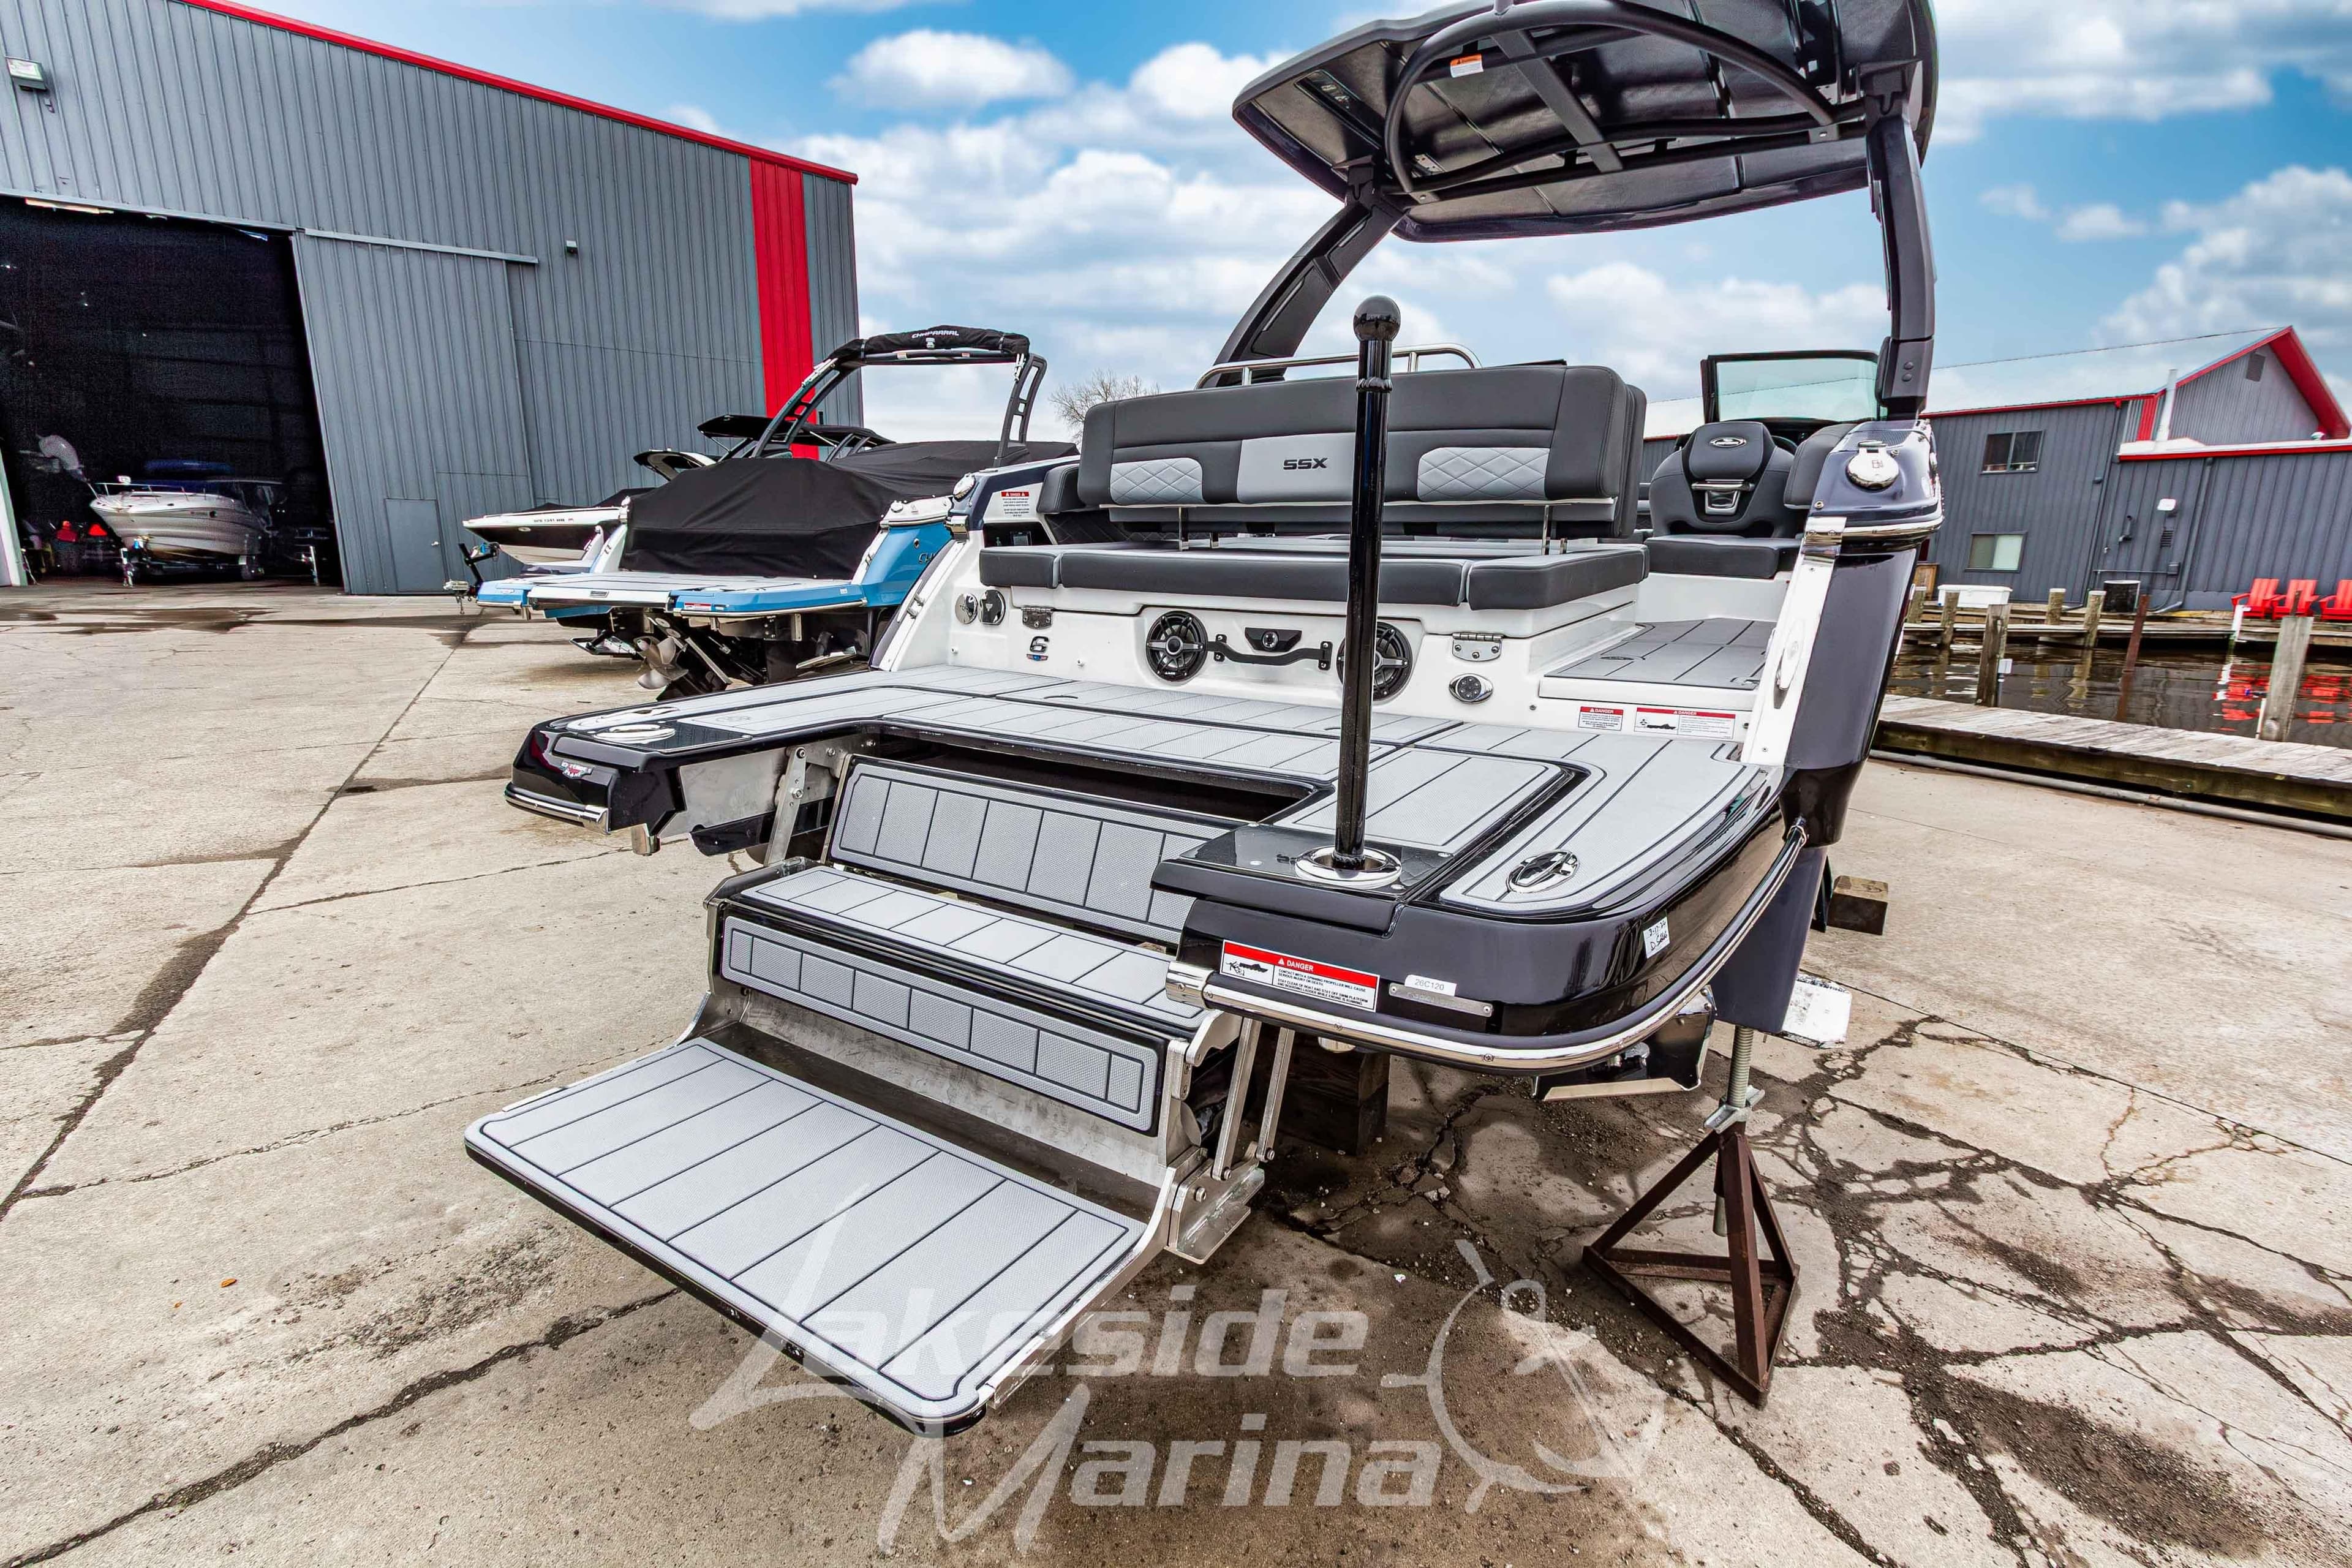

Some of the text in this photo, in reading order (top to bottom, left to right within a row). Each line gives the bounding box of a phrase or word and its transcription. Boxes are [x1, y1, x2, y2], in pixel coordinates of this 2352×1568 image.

[911, 330, 959, 339] CHAPARRAL
[1283, 457, 1328, 470] SSX
[1030, 636, 1049, 654] 6
[1287, 960, 1314, 972] DANGER
[1414, 978, 1445, 991] 26C120
